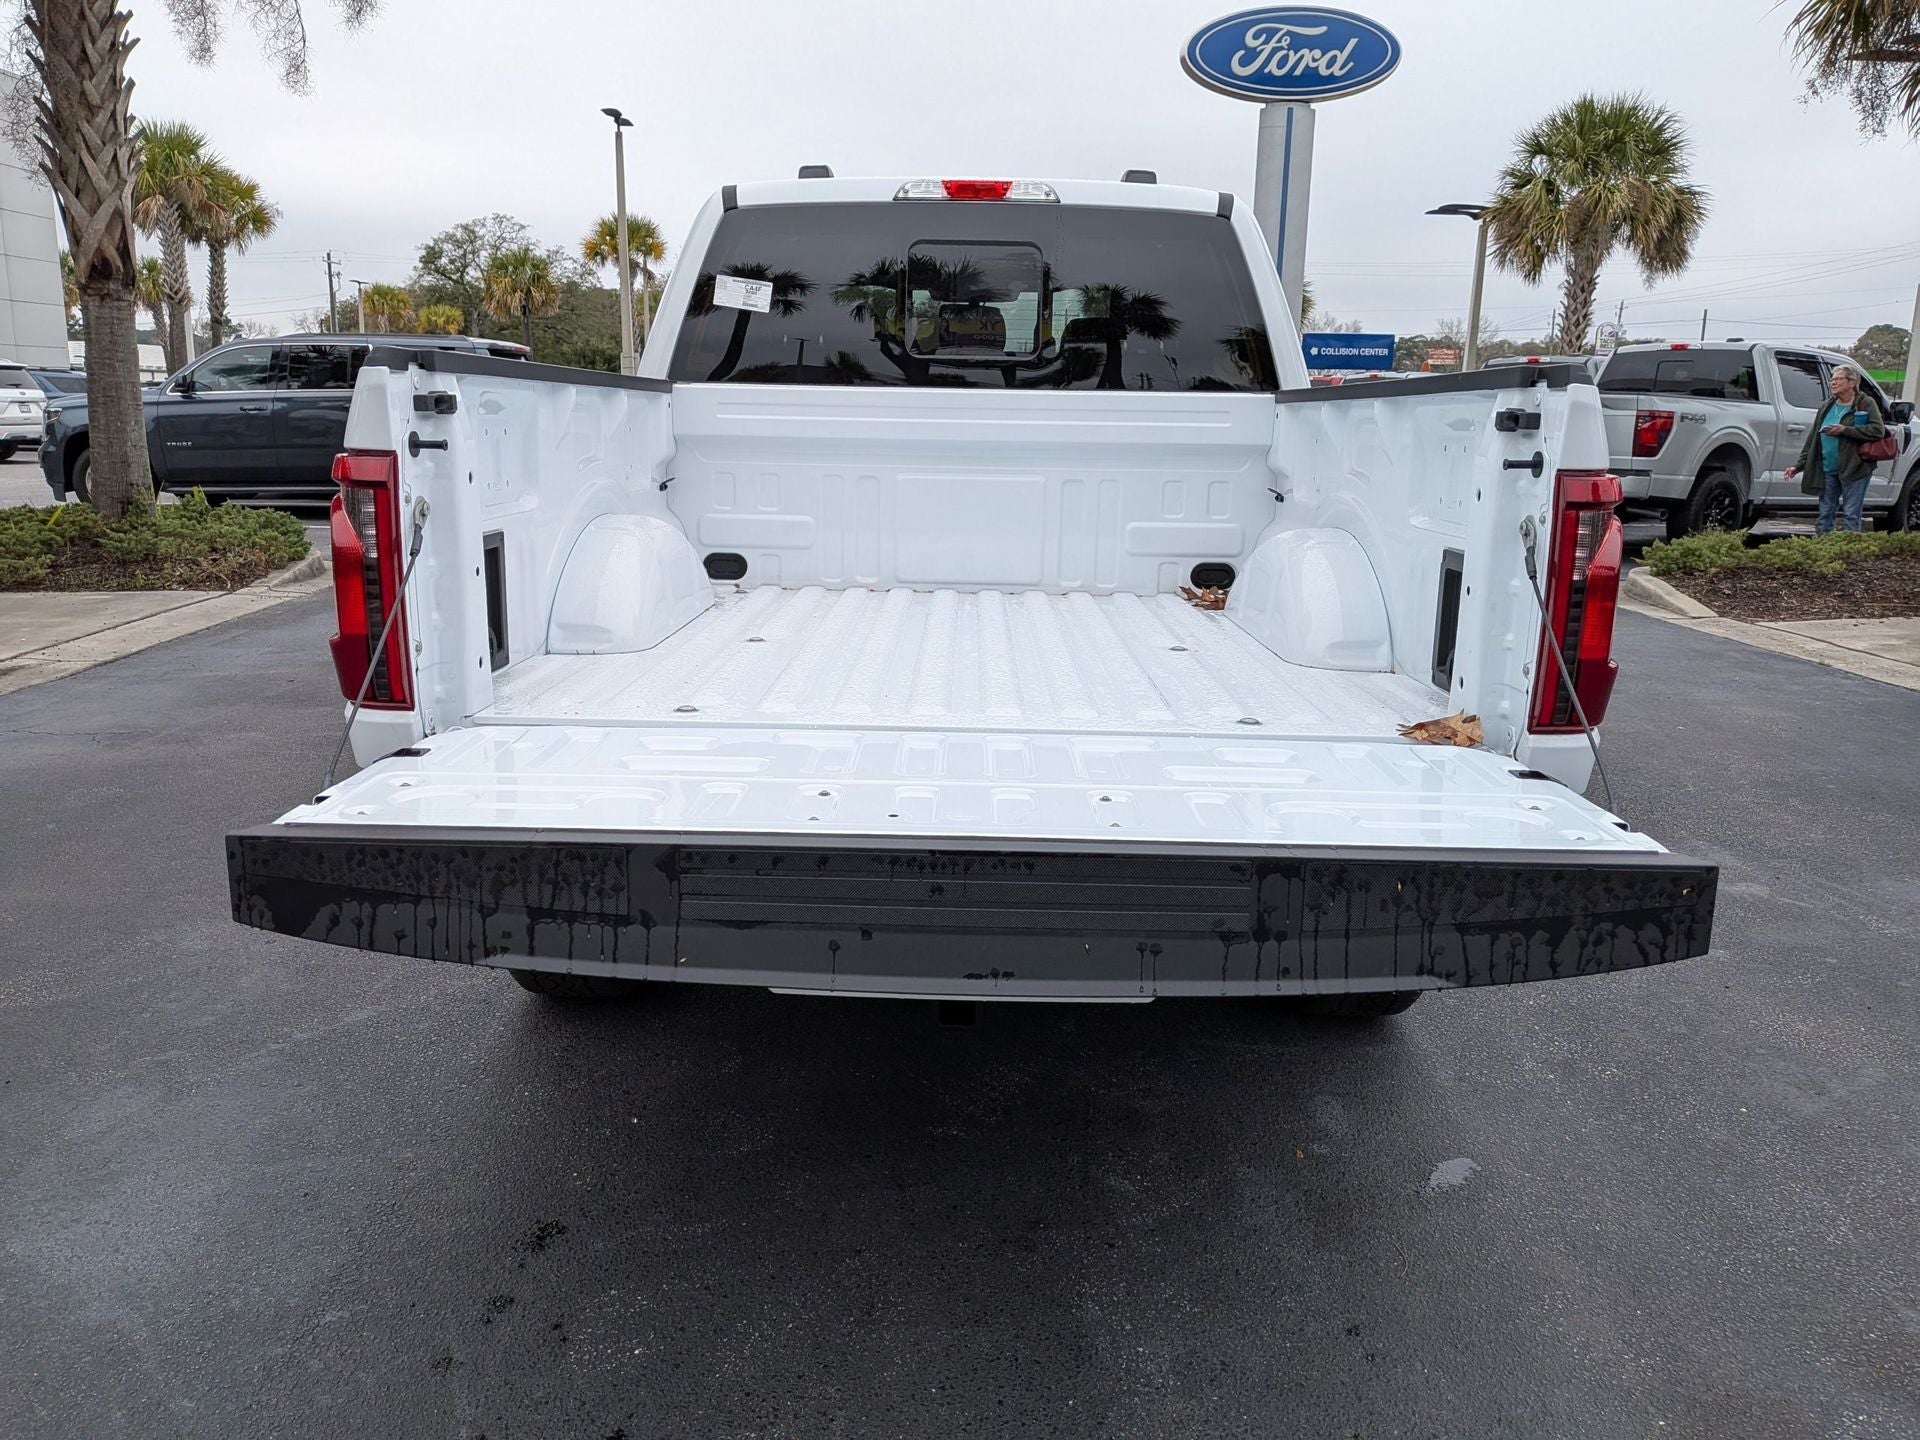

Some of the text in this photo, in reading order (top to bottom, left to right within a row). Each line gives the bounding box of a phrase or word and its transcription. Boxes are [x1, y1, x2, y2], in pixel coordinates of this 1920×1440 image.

[1231, 23, 1359, 77] Ford
[1320, 347, 1389, 356] COLLISION CENTER
[1680, 412, 1706, 424] FX4
